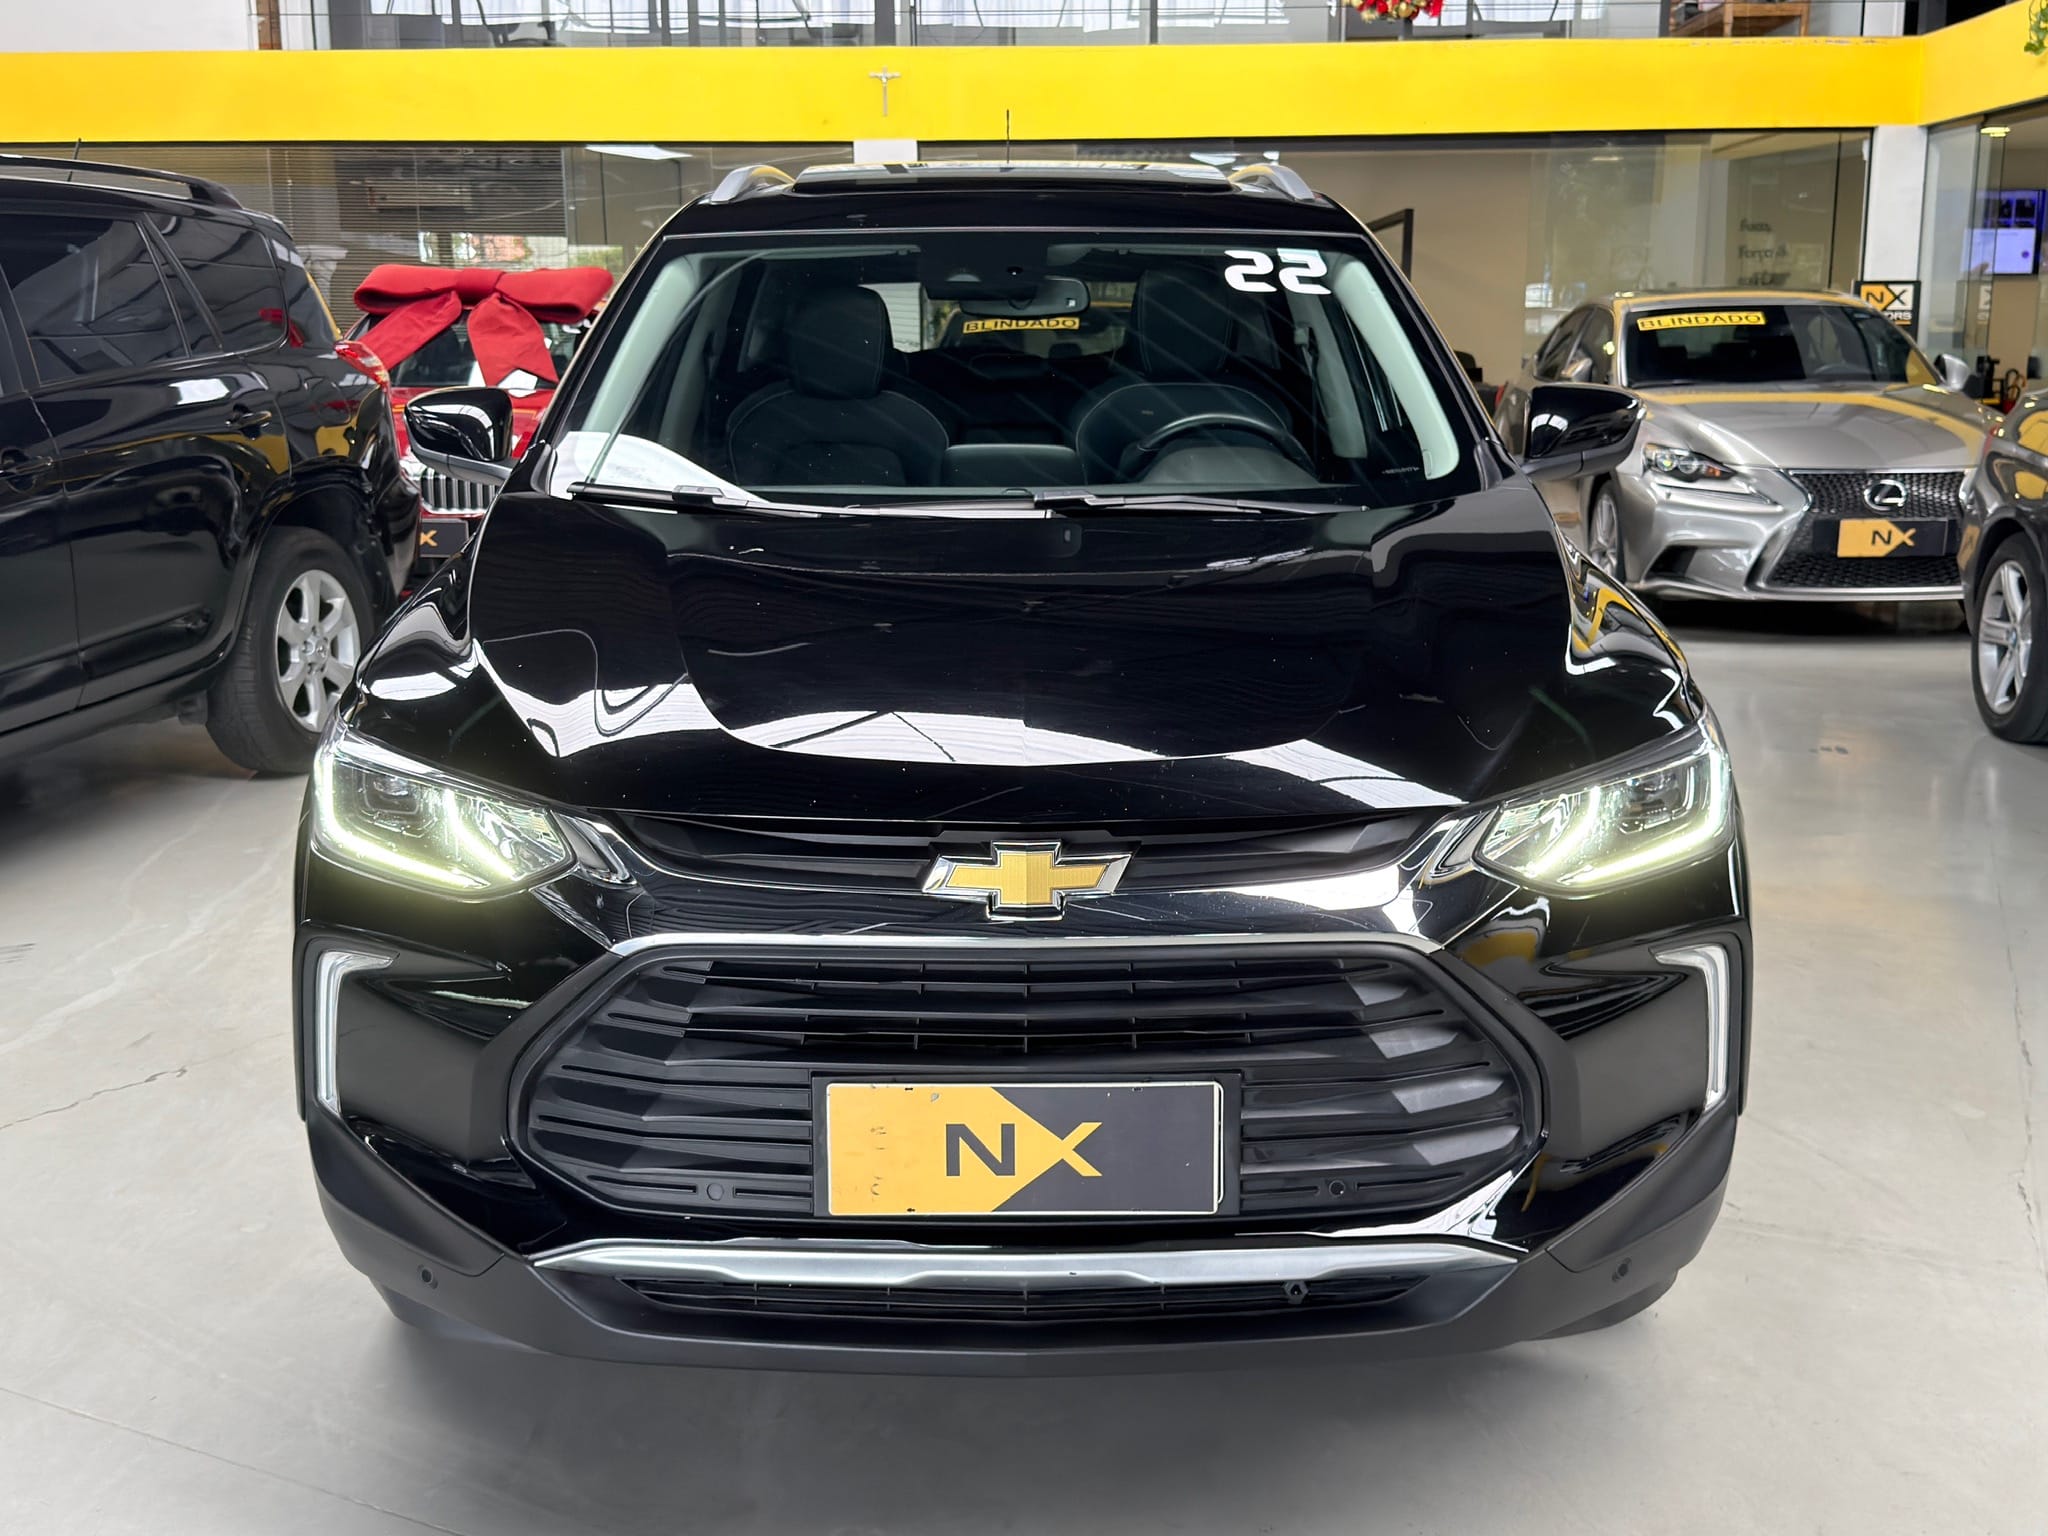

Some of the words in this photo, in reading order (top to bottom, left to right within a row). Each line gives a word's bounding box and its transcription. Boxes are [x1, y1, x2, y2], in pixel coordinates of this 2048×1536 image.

[1224, 248, 1332, 295] 22
[1866, 285, 1908, 310] NX
[965, 319, 1077, 332] BLINDADO
[1640, 314, 1761, 329] BLINDADO
[1871, 528, 1917, 547] NX
[945, 1121, 1103, 1178] NX
